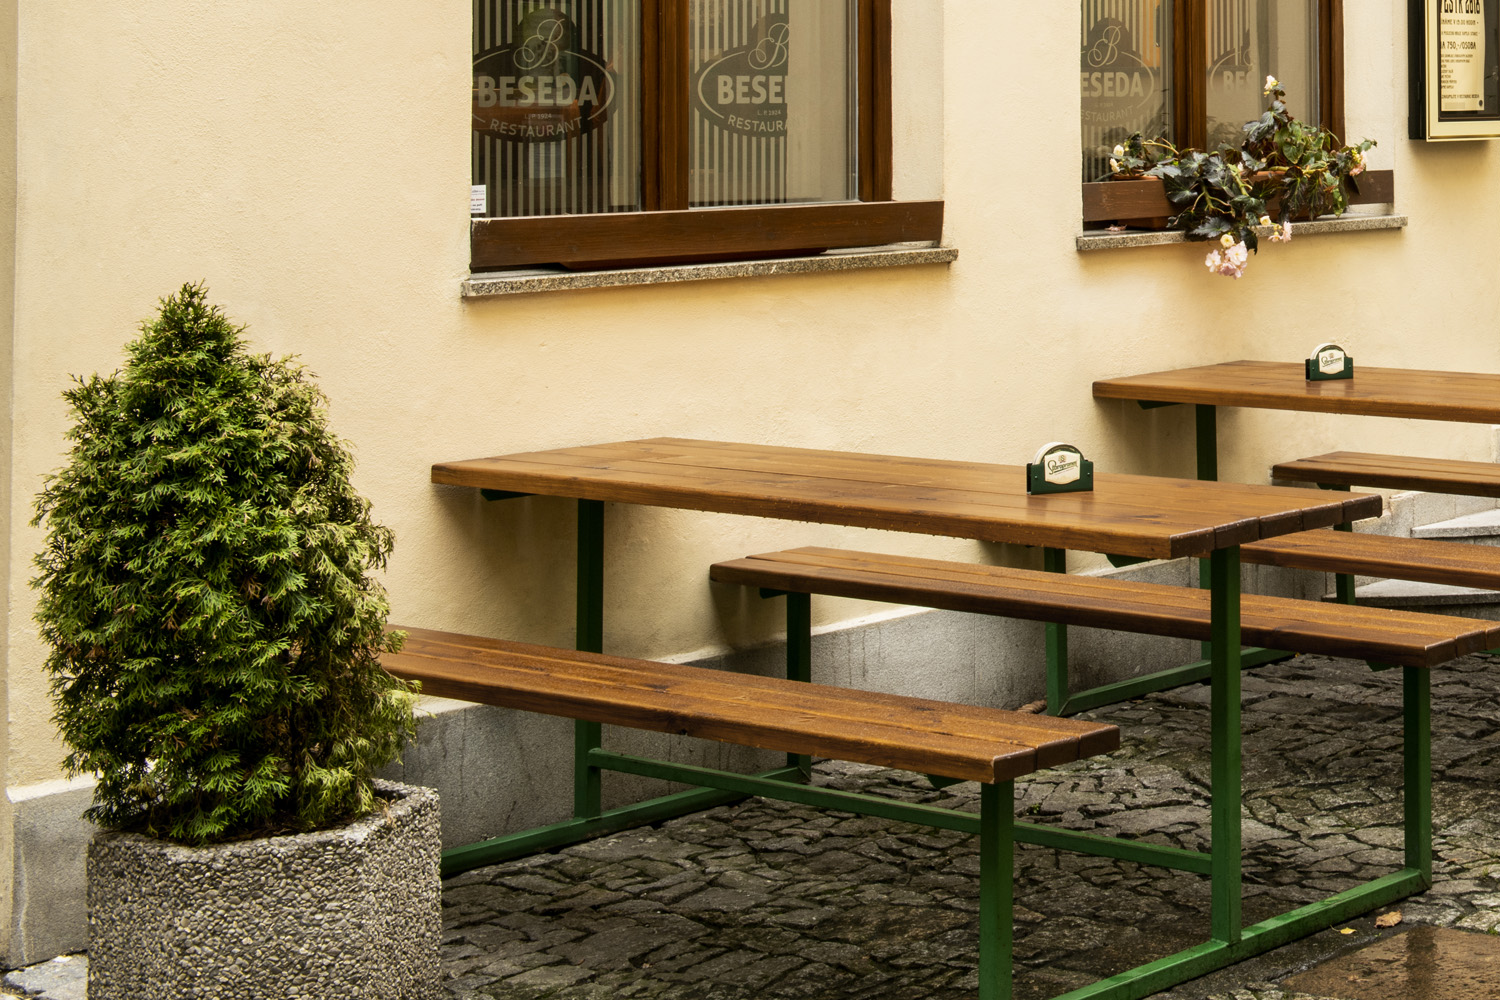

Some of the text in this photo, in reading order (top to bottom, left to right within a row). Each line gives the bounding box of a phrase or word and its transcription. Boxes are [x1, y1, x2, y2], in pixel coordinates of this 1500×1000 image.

[514, 18, 565, 70] B
[478, 75, 598, 108] BESEDA
[490, 116, 582, 137] RESTAURANT
